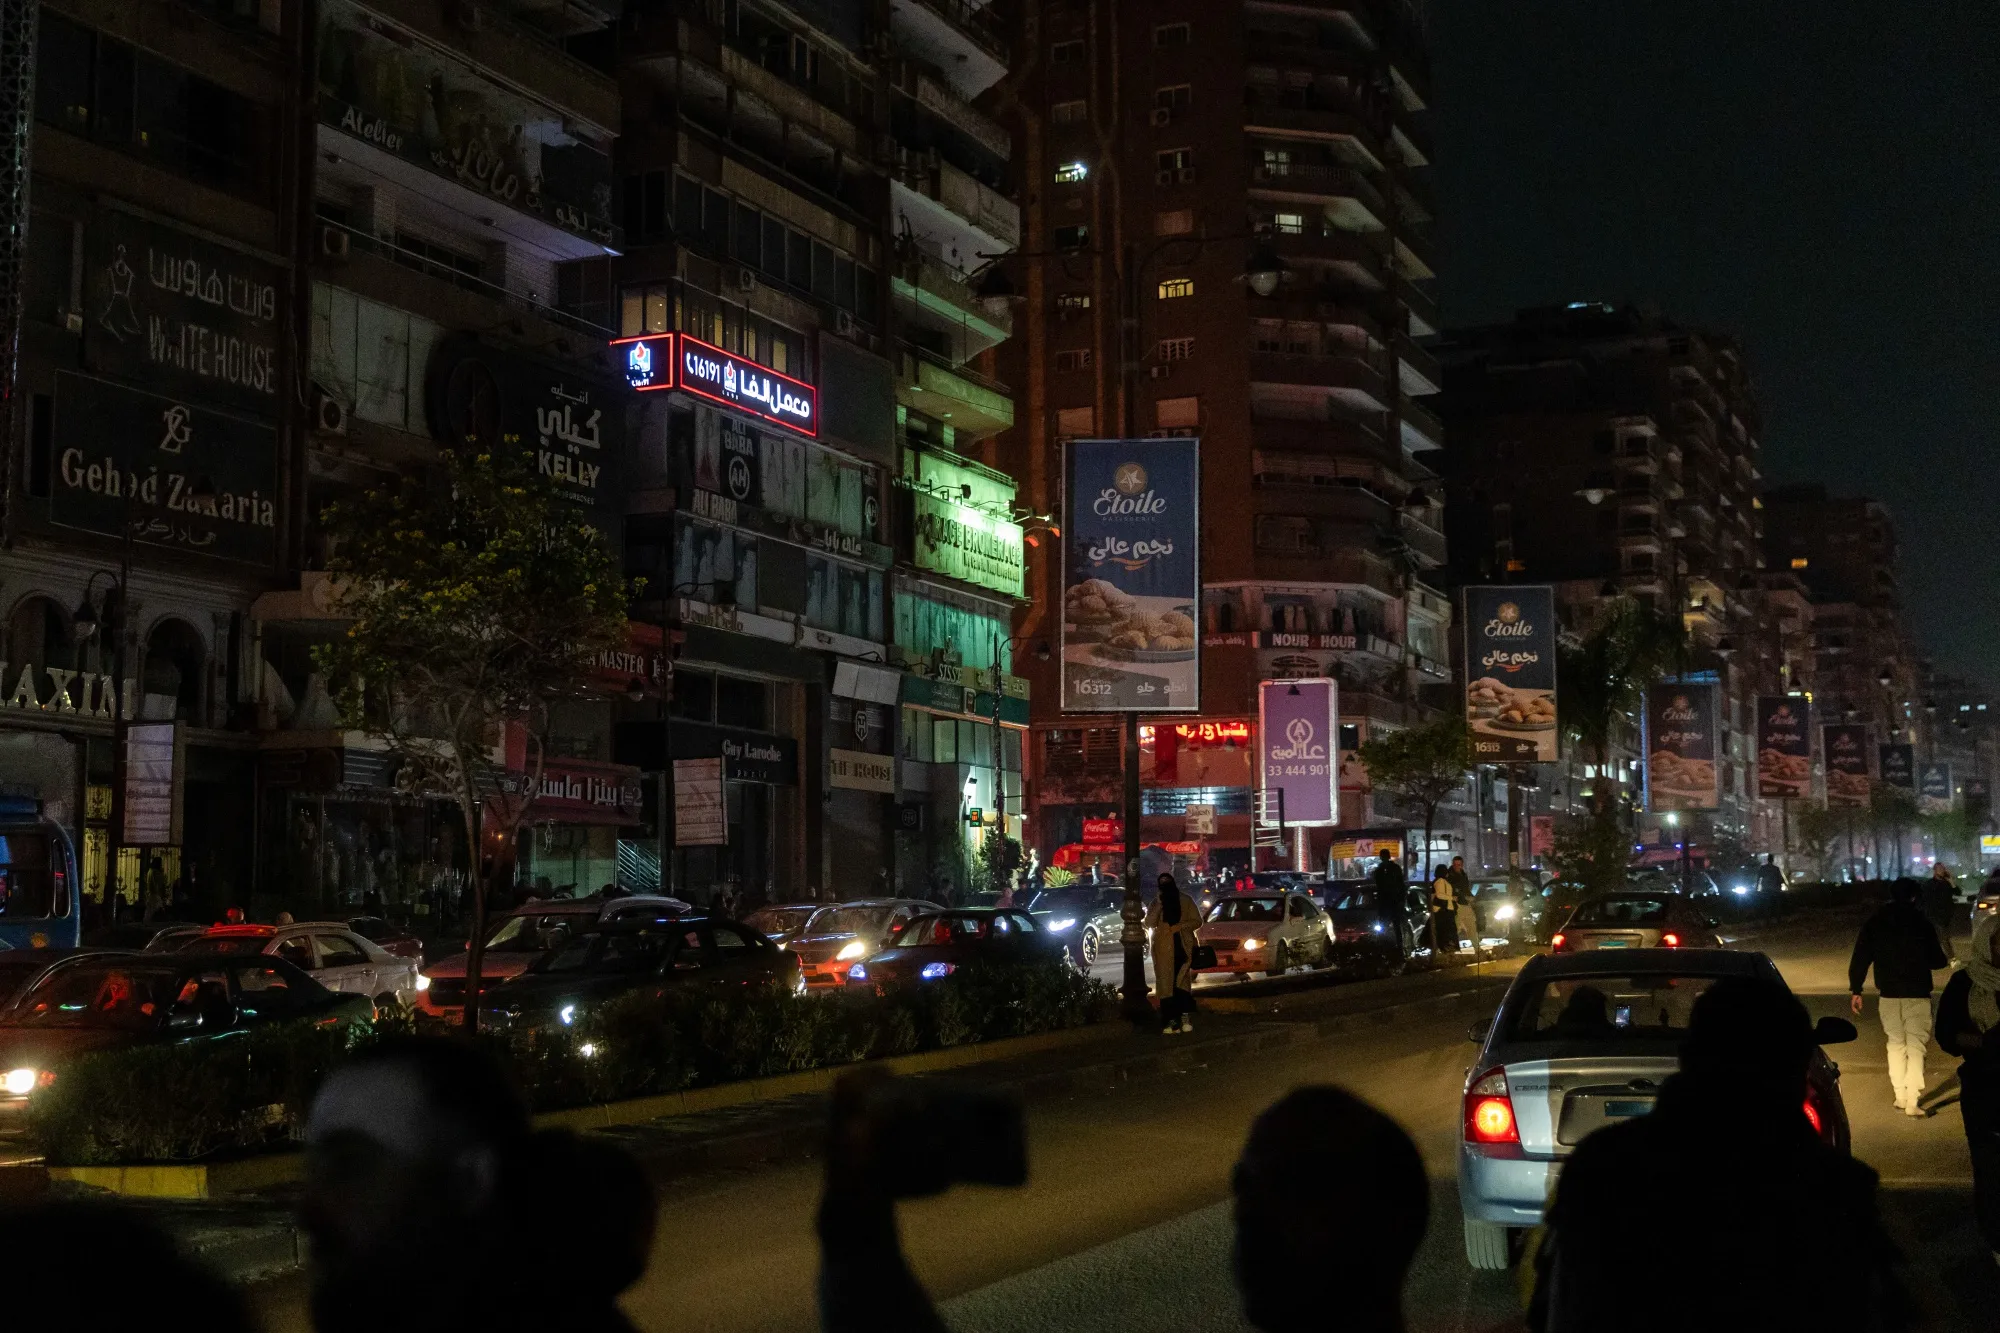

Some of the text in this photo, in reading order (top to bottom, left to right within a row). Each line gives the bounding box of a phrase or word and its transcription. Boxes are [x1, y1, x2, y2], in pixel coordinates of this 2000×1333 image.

[214, 333, 275, 394] HOUSE
[694, 355, 720, 384] 16191
[538, 449, 601, 488] KELLY
[599, 648, 645, 675] MASTER
[1073, 679, 1112, 695] 16312
[721, 738, 782, 763] Guy Laroche
[1268, 764, 1329, 776] 33 444 901
